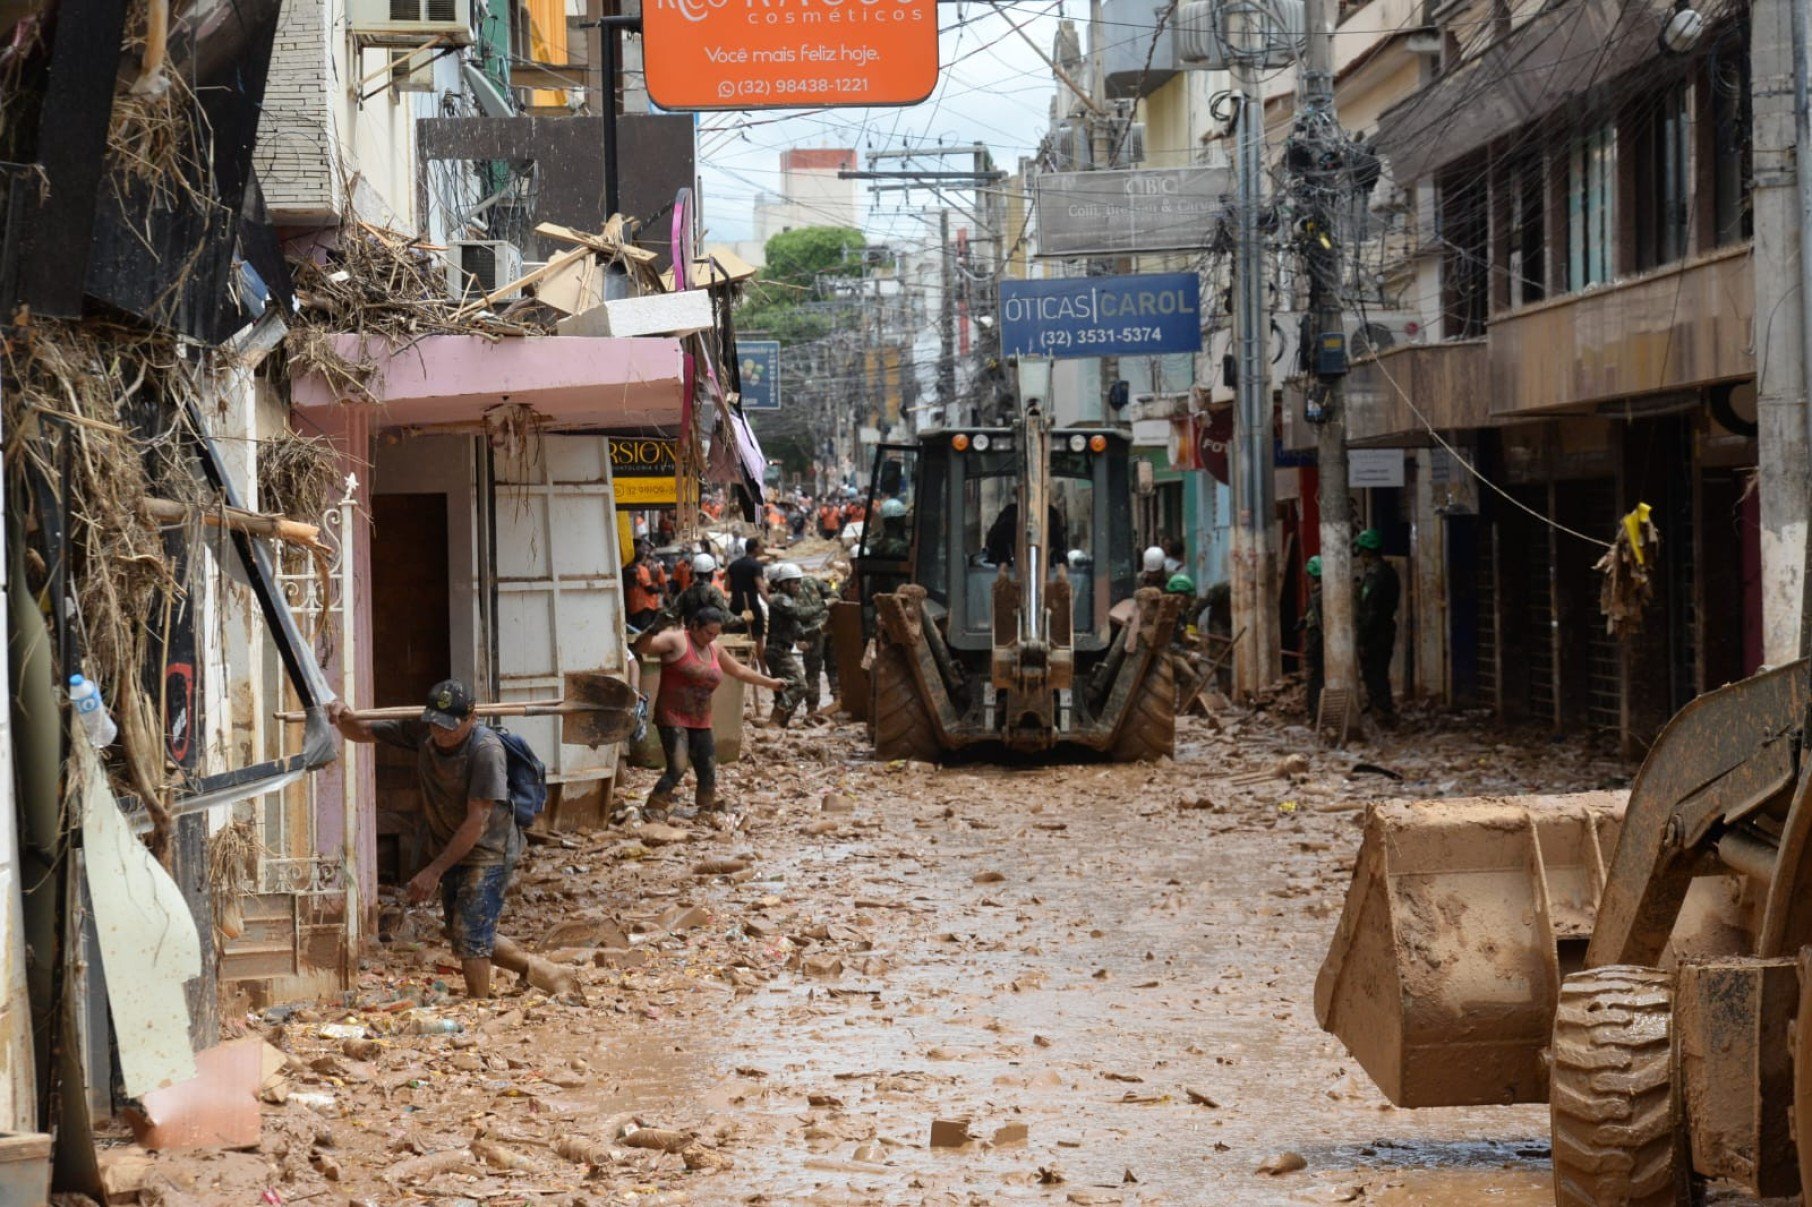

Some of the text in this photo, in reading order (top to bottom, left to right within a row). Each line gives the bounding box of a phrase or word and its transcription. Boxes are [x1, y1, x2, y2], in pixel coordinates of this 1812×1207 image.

[747, 8, 922, 24] cosméticos
[704, 44, 880, 66] Você mais feliz hoje.
[738, 78, 868, 96] (32) 98438-1221
[1161, 198, 1172, 213] &
[1005, 290, 1195, 322] ÓTICAS CAROL
[1040, 327, 1162, 347] (32) 3531-5374
